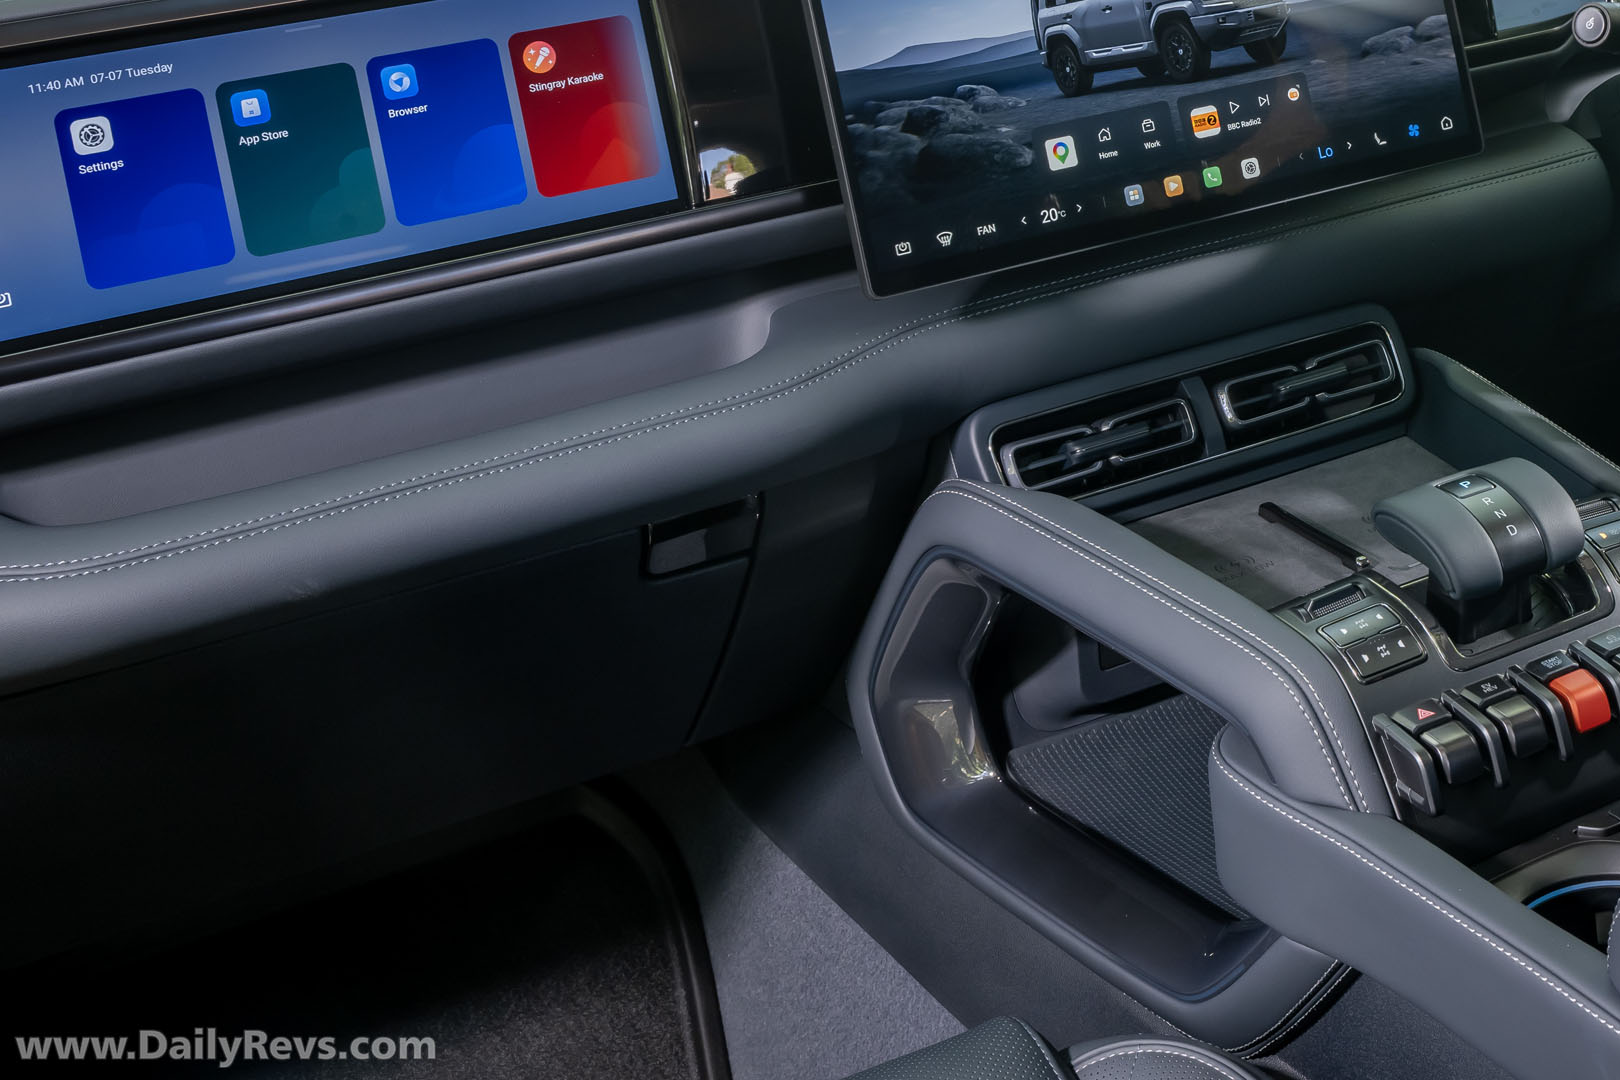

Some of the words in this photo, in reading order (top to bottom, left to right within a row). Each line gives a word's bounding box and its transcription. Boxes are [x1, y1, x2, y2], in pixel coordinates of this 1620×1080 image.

[28, 79, 61, 94] 11:40
[64, 76, 85, 89] AM
[90, 69, 122, 84] 07-07
[125, 63, 174, 79] Tuesday
[528, 79, 566, 93] Stingray
[567, 72, 605, 86] Karaoke
[388, 104, 428, 118] Browser
[1227, 122, 1241, 131] BBC
[1241, 117, 1262, 129] Radio2
[238, 135, 260, 146] App
[262, 129, 289, 142] Store
[1144, 139, 1161, 150] Work
[1098, 150, 1118, 159] Home
[1318, 146, 1333, 159] Lo
[78, 160, 124, 175] Settings
[977, 224, 996, 236] FAN
[1482, 497, 1494, 506] R
[1494, 508, 1507, 519] N
[1506, 524, 1518, 536] D
[1482, 684, 1498, 694] HEV
